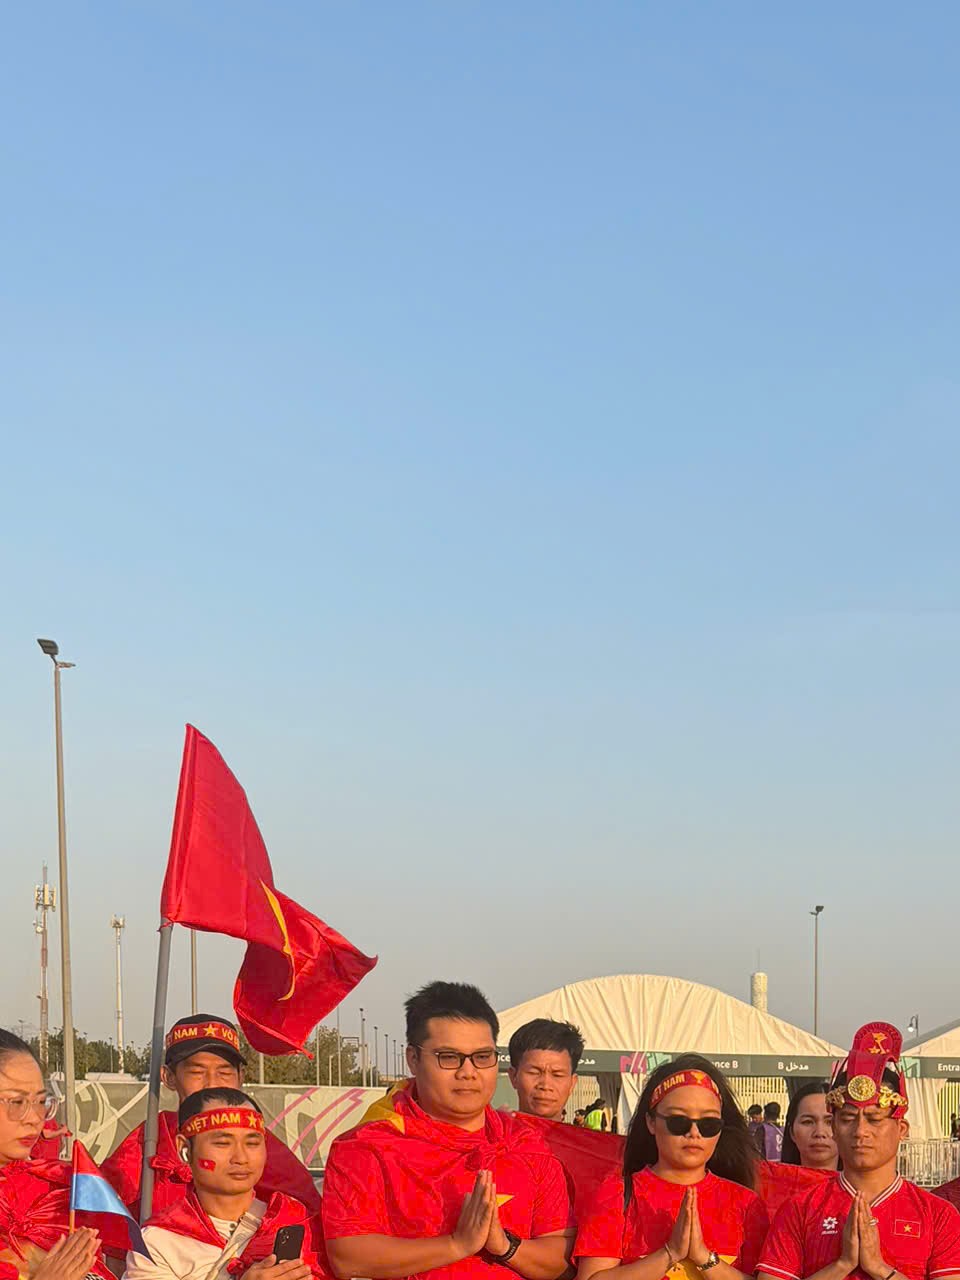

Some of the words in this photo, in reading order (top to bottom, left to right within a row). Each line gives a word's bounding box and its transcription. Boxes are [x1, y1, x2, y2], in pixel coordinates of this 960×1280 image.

[174, 1027, 198, 1040] NAM
[663, 1073, 686, 1091] NAM
[210, 1112, 241, 1125] NAM
